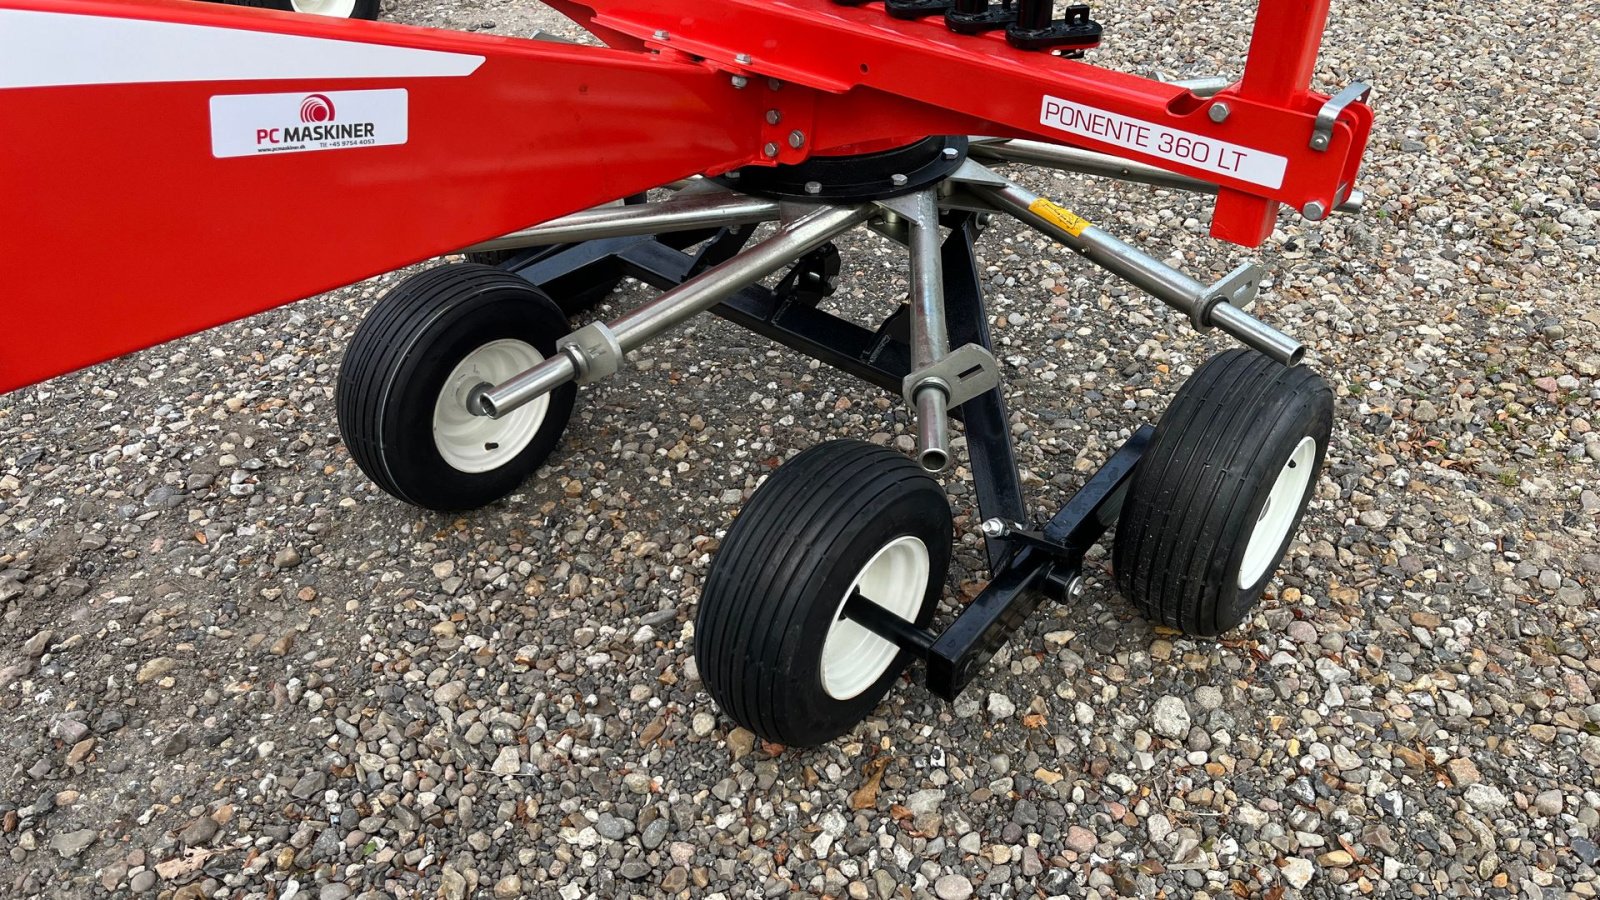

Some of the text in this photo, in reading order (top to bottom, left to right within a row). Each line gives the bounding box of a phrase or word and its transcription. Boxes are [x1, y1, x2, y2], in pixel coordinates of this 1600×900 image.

[256, 123, 375, 145] PC MASKINER
[1045, 101, 1248, 172] PONENTE 360 LT
[257, 145, 306, 153] www.pcmaskiner.dk
